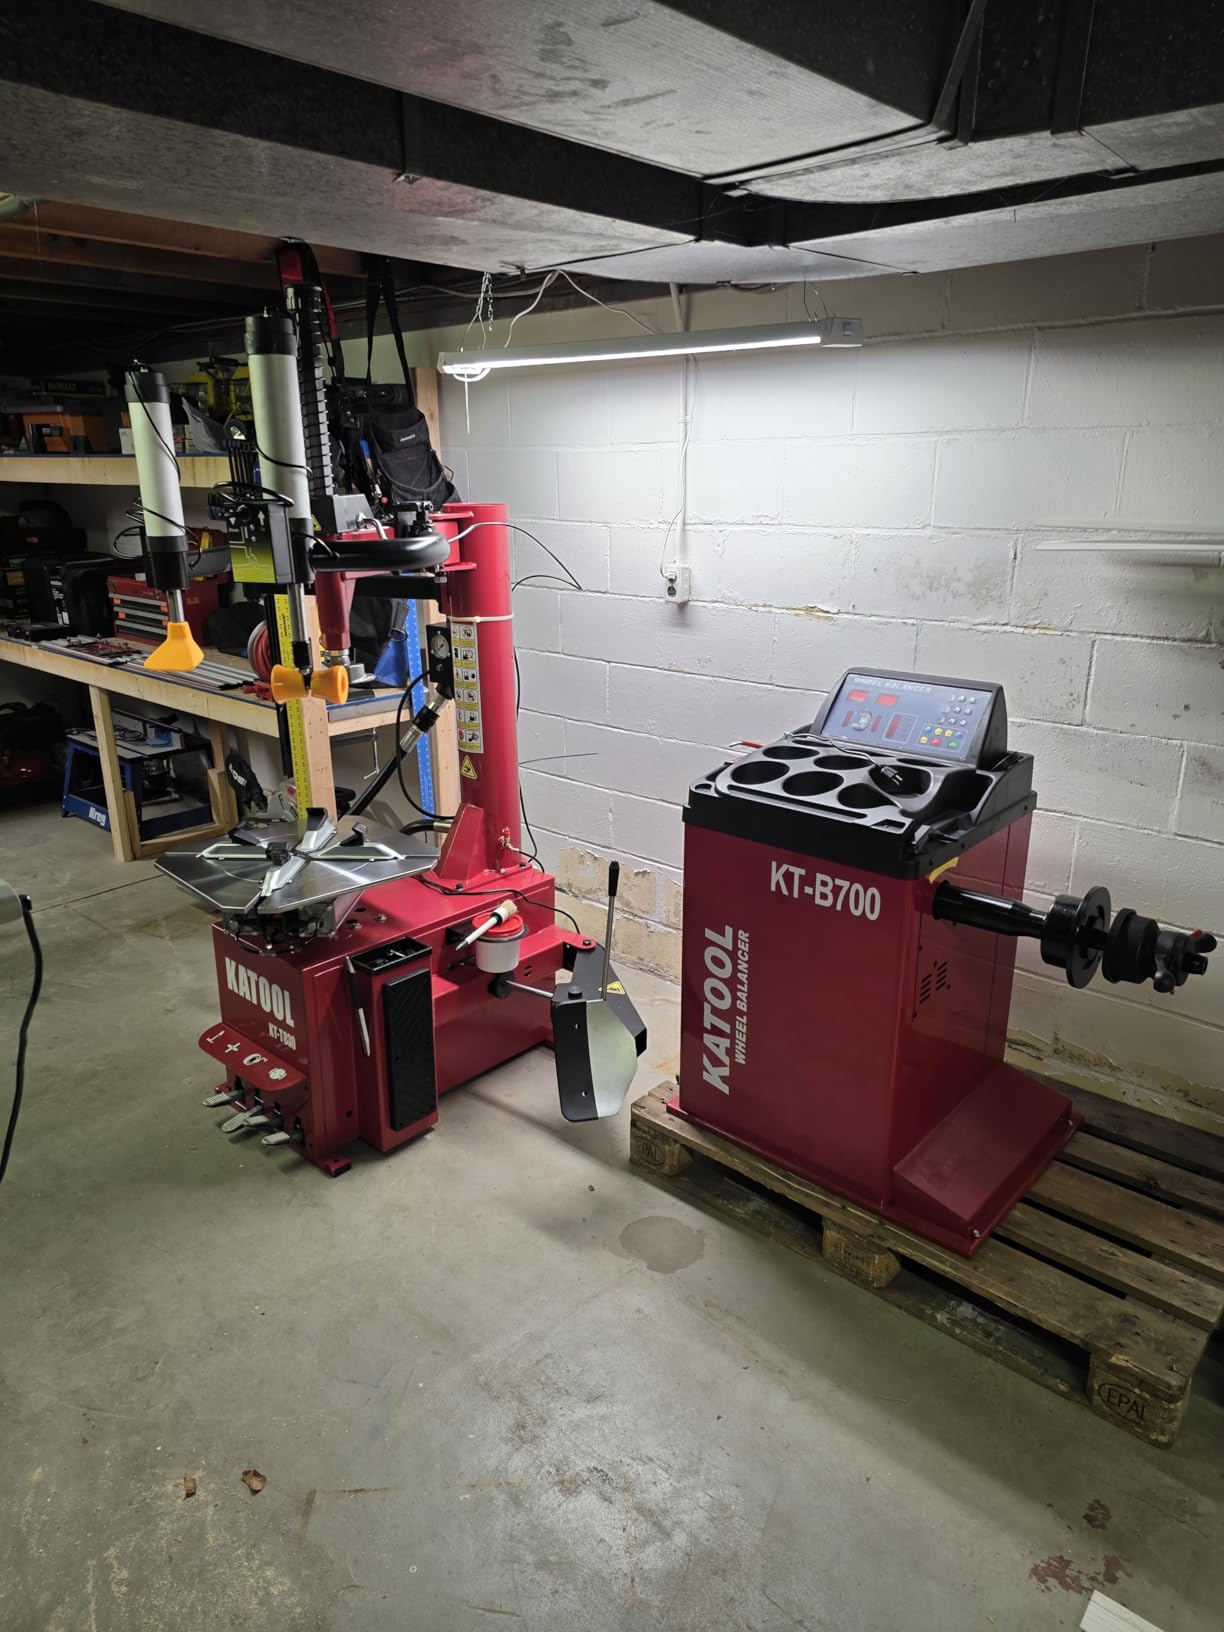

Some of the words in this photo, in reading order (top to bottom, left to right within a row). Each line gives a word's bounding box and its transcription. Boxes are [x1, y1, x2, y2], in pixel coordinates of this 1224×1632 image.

[770, 860, 881, 921] KT-B700
[225, 956, 294, 1028] KATOOL
[736, 930, 750, 1013] BALANCER
[702, 925, 733, 1096] KATOOL
[735, 1015, 747, 1065] WHEEL
